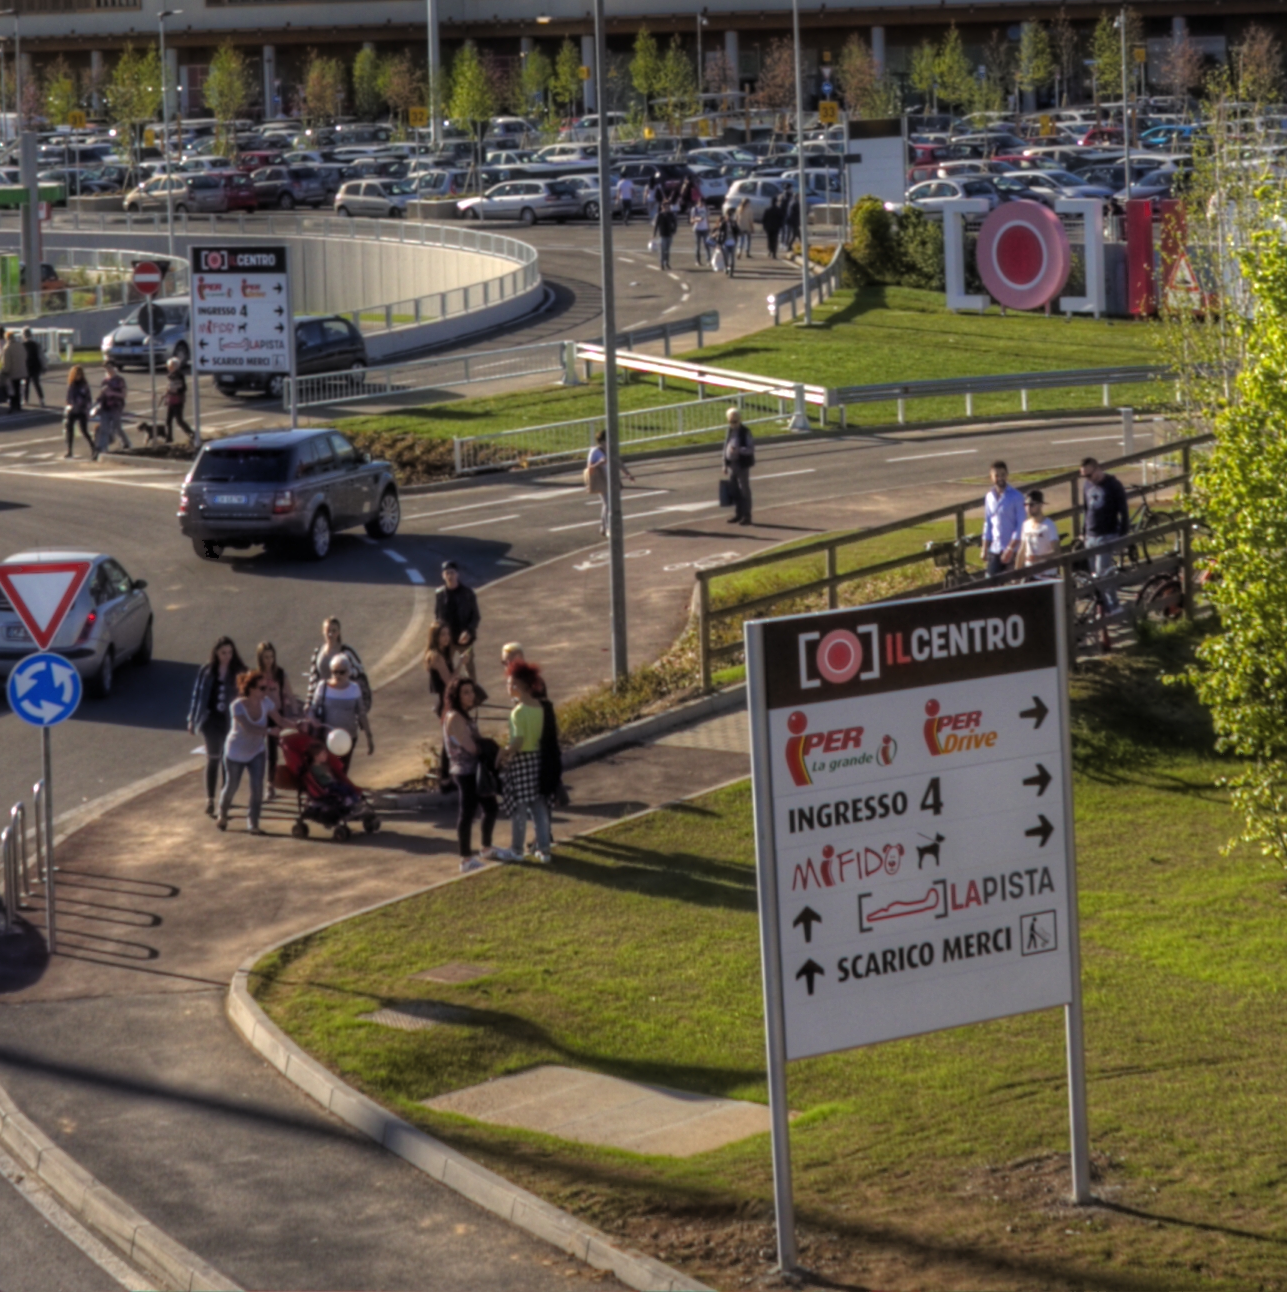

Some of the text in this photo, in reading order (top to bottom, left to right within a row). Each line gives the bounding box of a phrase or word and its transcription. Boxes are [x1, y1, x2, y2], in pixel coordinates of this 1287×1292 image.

[411, 112, 424, 122] 32
[822, 107, 835, 118] 33
[198, 304, 247, 318] INGRESSO 4
[212, 356, 270, 366] SCARICO MERCI
[942, 728, 998, 755] Drive
[811, 761, 827, 773] La
[829, 751, 873, 774] grande
[789, 777, 944, 834] INGRESSO 4
[837, 926, 1012, 983] SCARICO MERCI
